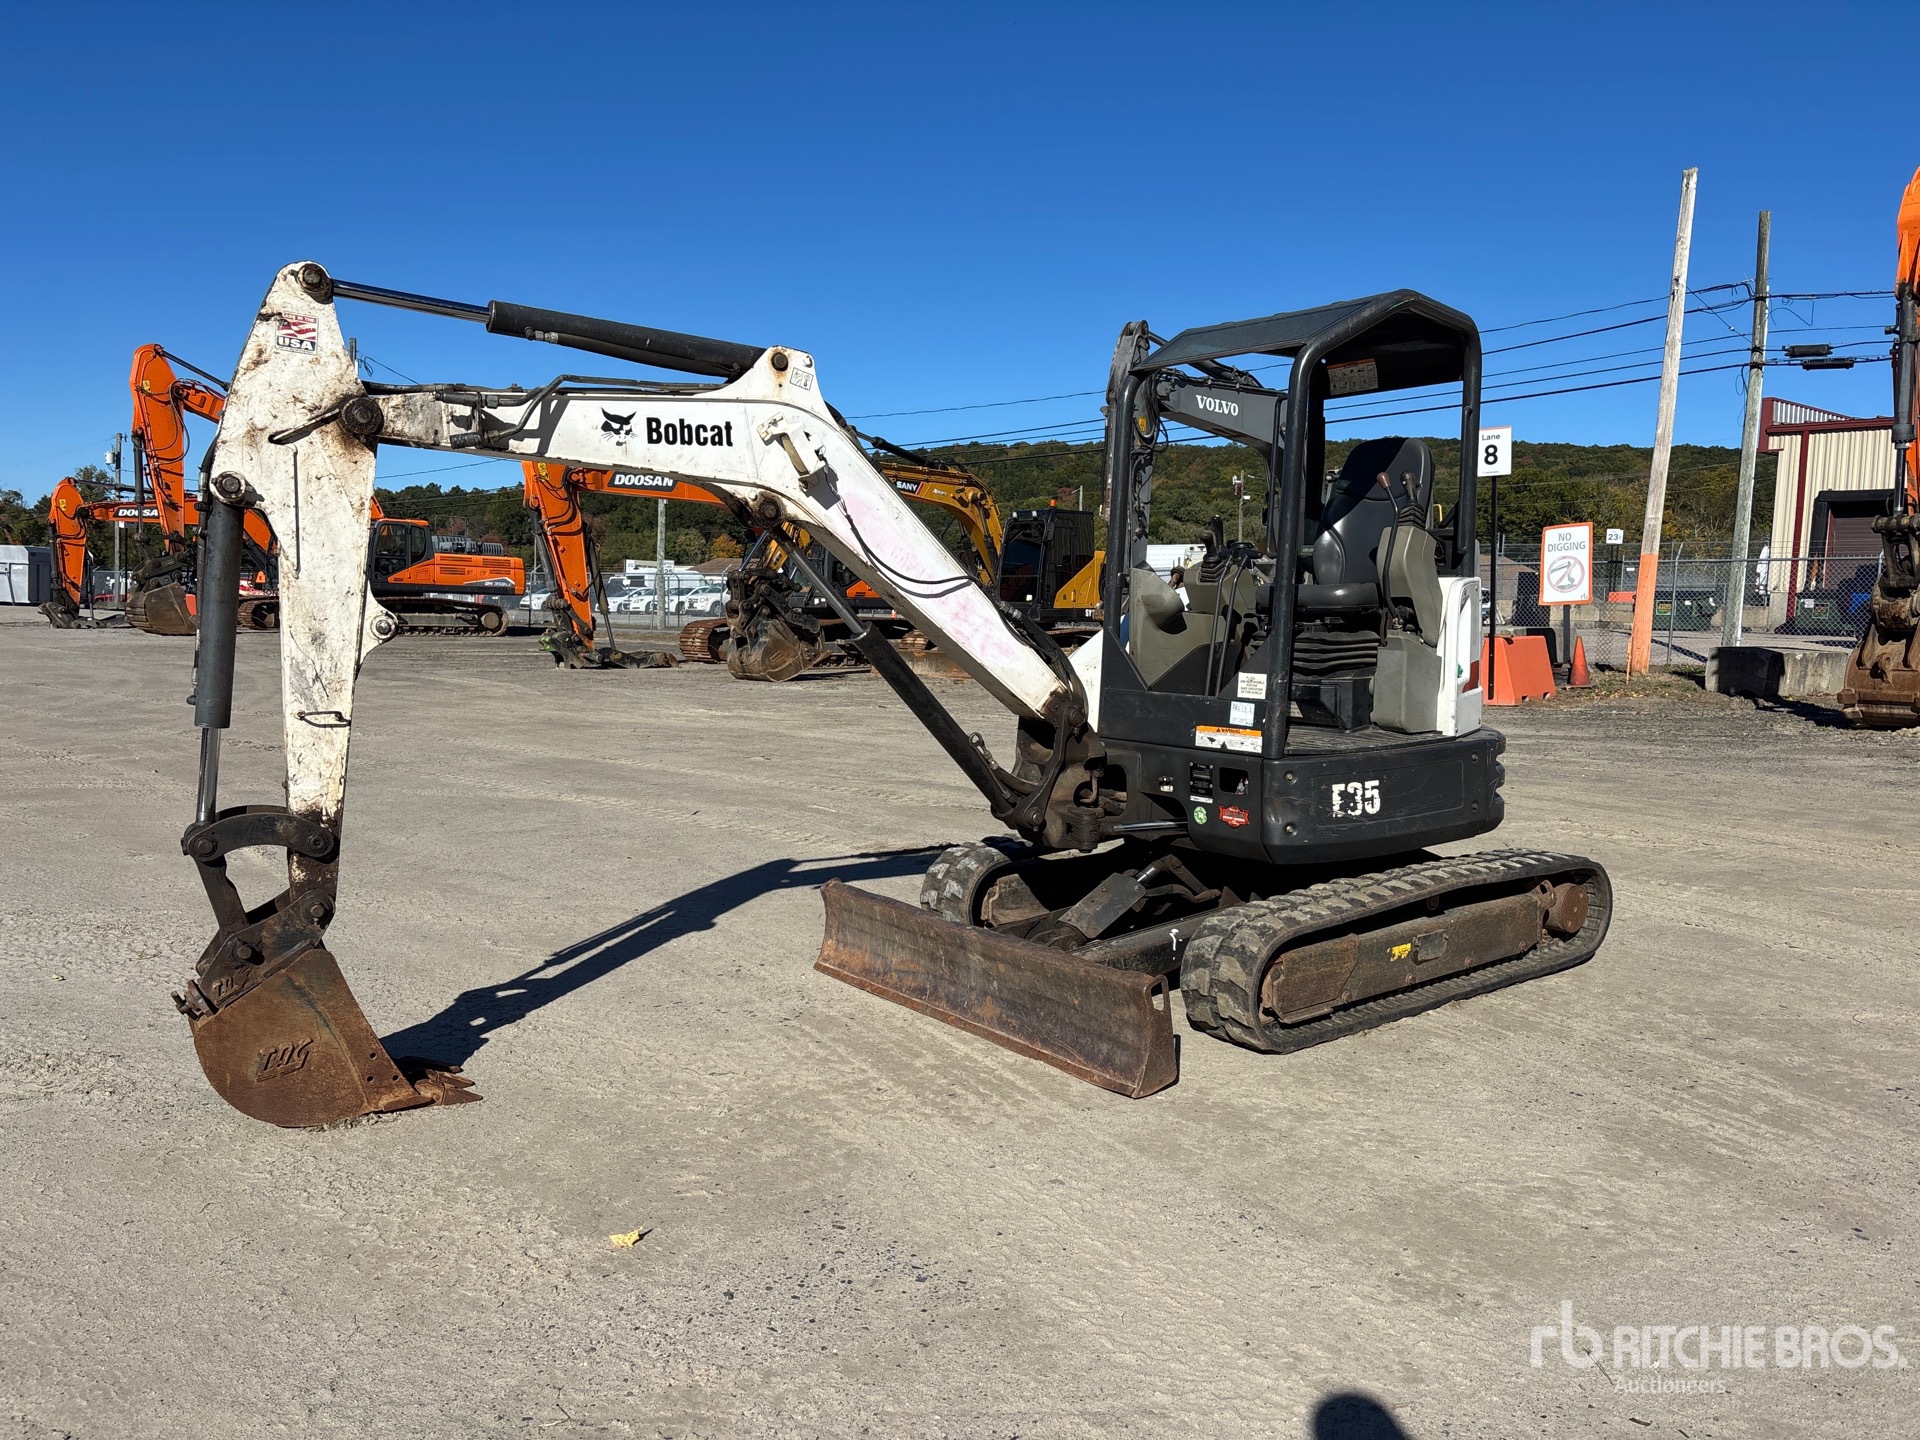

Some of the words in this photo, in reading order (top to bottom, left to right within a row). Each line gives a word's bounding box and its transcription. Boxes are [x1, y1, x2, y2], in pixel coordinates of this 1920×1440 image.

[278, 337, 314, 351] USA
[1195, 394, 1239, 417] VOLVO
[646, 416, 734, 447] Bobcat
[1484, 444, 1498, 465] 8
[614, 474, 674, 487] DOOSAN
[896, 481, 918, 492] SANY
[118, 508, 159, 517] DOSA
[1558, 532, 1572, 542] NO
[1608, 533, 1619, 541] 23
[1547, 541, 1586, 552] DIGGING
